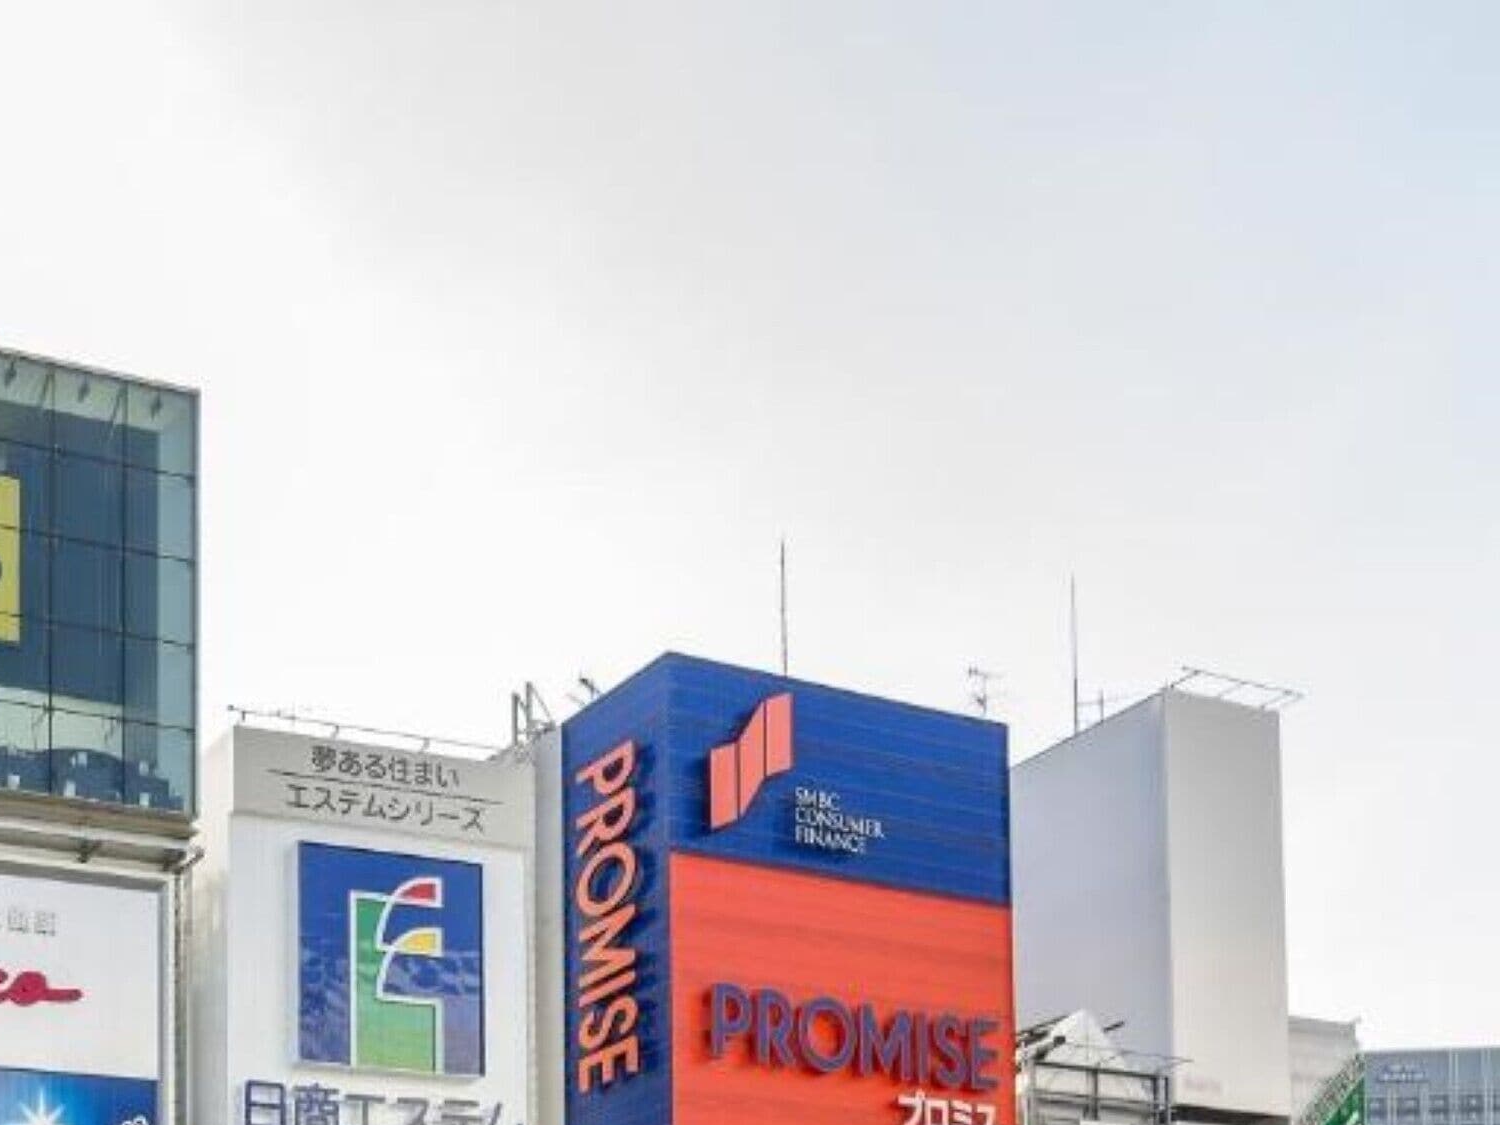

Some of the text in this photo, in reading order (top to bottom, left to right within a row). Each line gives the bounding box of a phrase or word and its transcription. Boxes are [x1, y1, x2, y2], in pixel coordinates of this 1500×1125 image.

[310, 745, 461, 788] 夢ある住まい
[286, 784, 486, 833] エステムシリーズ
[795, 786, 841, 812] SMBC
[795, 807, 885, 839] CONSUMER
[795, 825, 866, 854] FINANCE
[575, 739, 645, 1095] PROMISE
[709, 981, 1003, 1093] PROMISE
